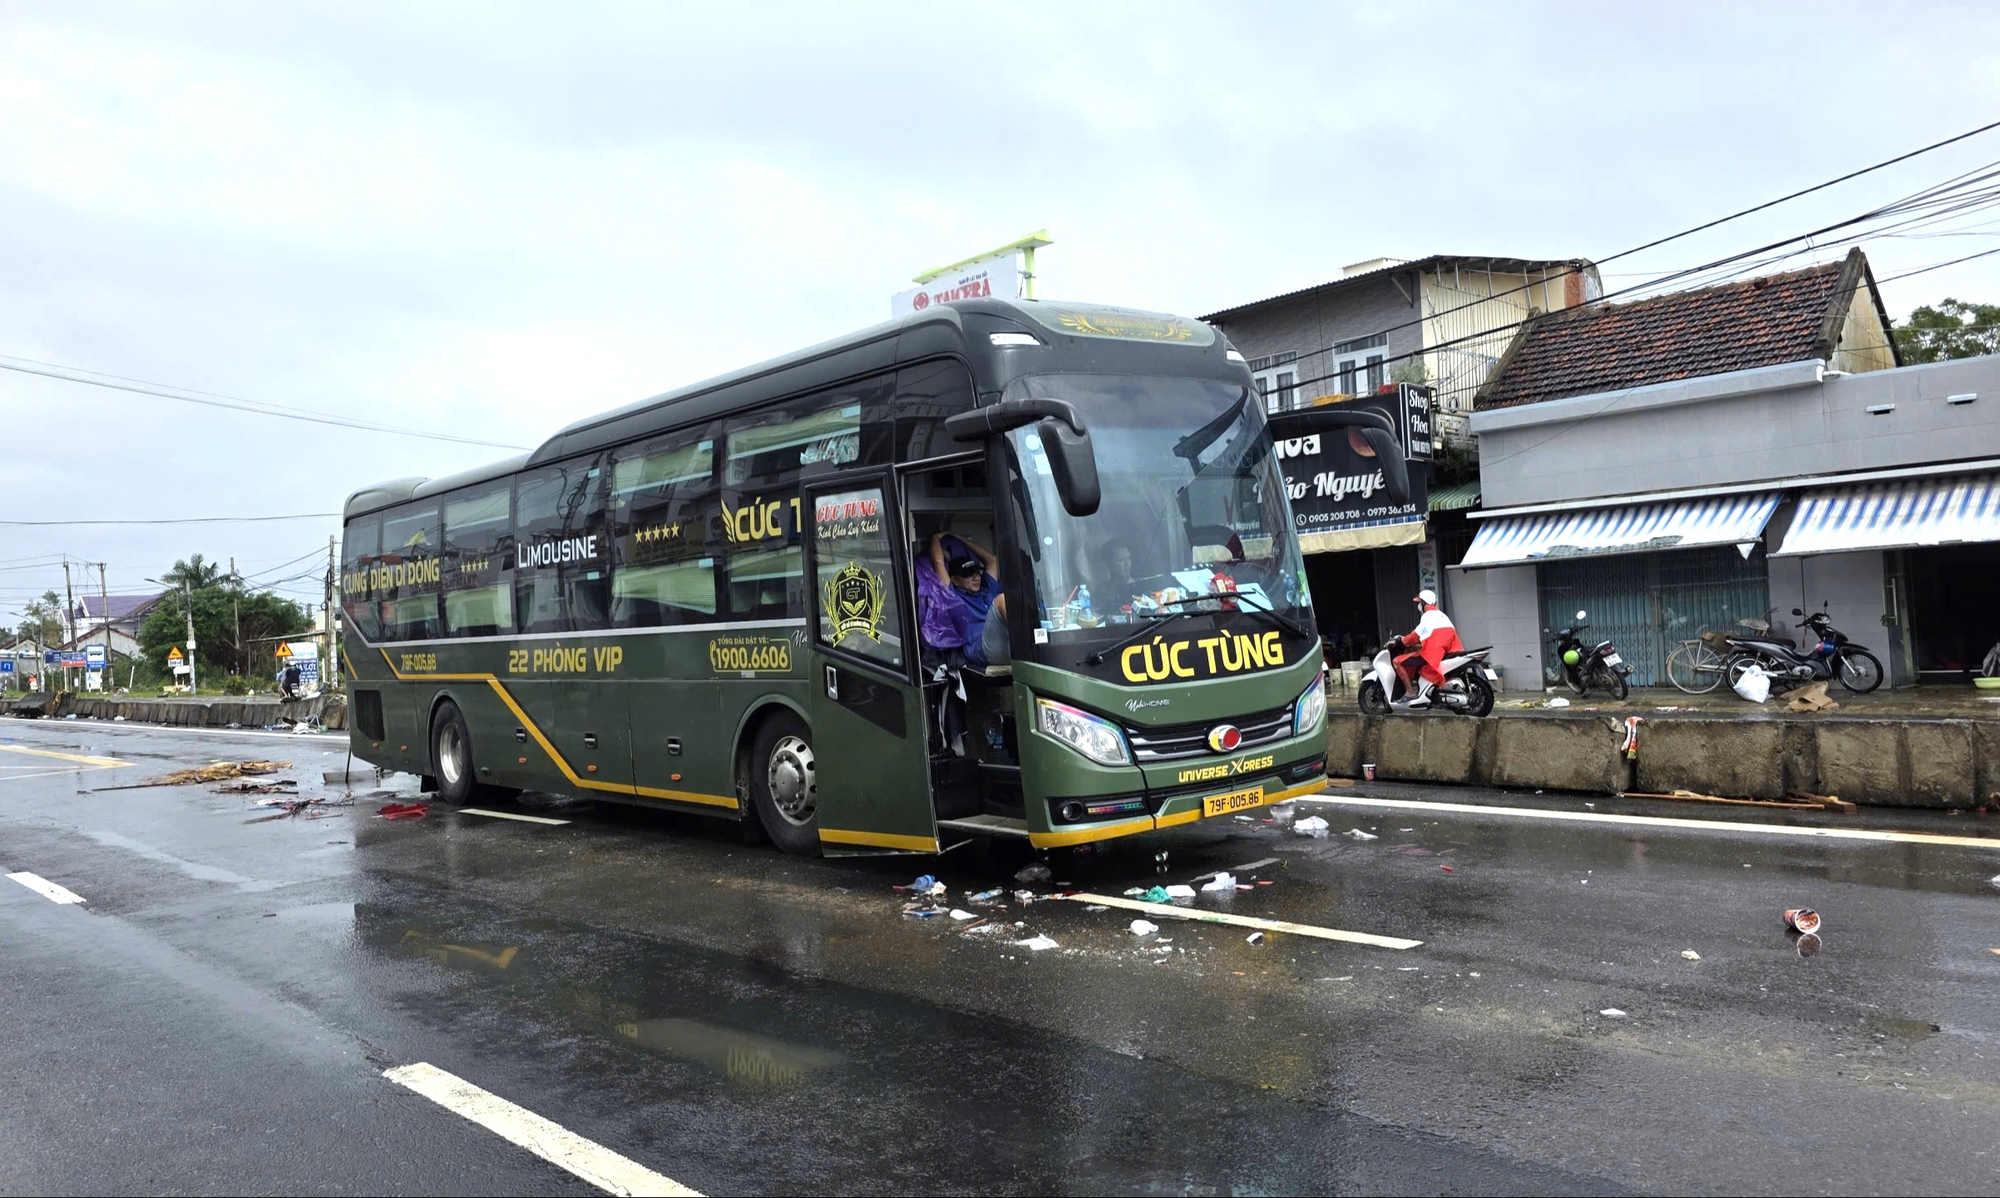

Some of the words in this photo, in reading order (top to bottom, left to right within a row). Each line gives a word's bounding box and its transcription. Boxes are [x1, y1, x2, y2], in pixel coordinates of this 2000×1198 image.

[1409, 389, 1428, 414] Shop
[1411, 414, 1429, 434] Hoa
[735, 496, 782, 541] CÚC
[816, 501, 840, 523] CÚC
[843, 498, 877, 519] TÙNG
[1308, 513, 1329, 523] 0905
[1329, 511, 1345, 521] 208
[1346, 509, 1360, 519] 708
[1367, 507, 1388, 517] 0979
[1402, 503, 1416, 513] 134
[518, 535, 598, 568] LIMOUSINE
[343, 571, 367, 594] CUNG
[396, 563, 406, 587] DI
[509, 650, 528, 672] 22
[534, 642, 587, 672] PHÒNG
[593, 646, 623, 672] VIP
[716, 645, 788, 669] 1900.6606
[1121, 635, 1195, 682] CÚC
[1197, 629, 1284, 674] TÙNG
[1179, 765, 1229, 783] UNIVERSE
